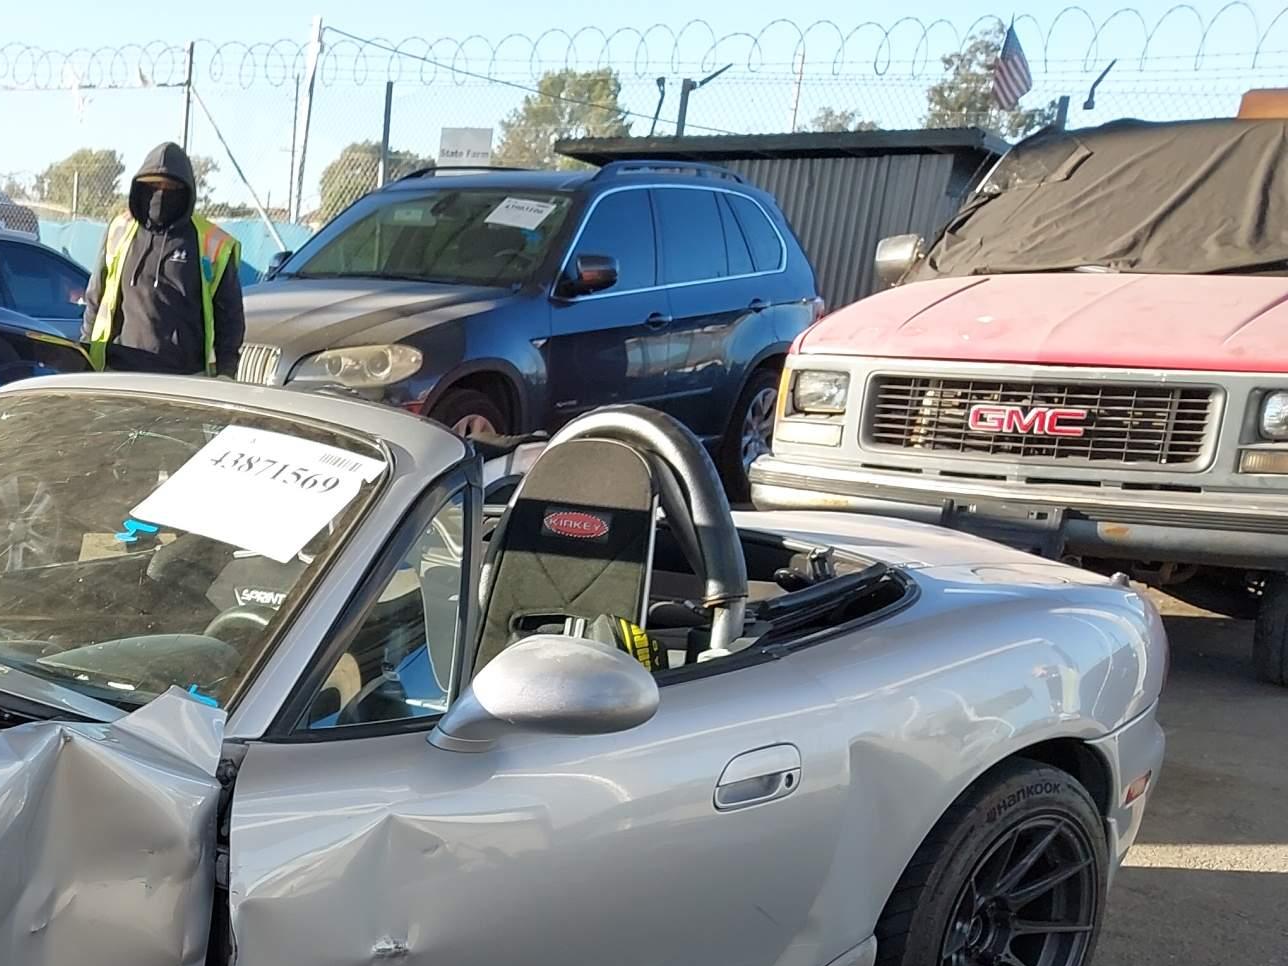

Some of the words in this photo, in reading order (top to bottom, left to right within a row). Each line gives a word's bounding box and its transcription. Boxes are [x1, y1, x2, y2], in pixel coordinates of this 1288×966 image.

[440, 148, 464, 159] State
[465, 148, 489, 159] Farm
[969, 404, 1087, 436] GMC
[210, 450, 340, 494] 43871569
